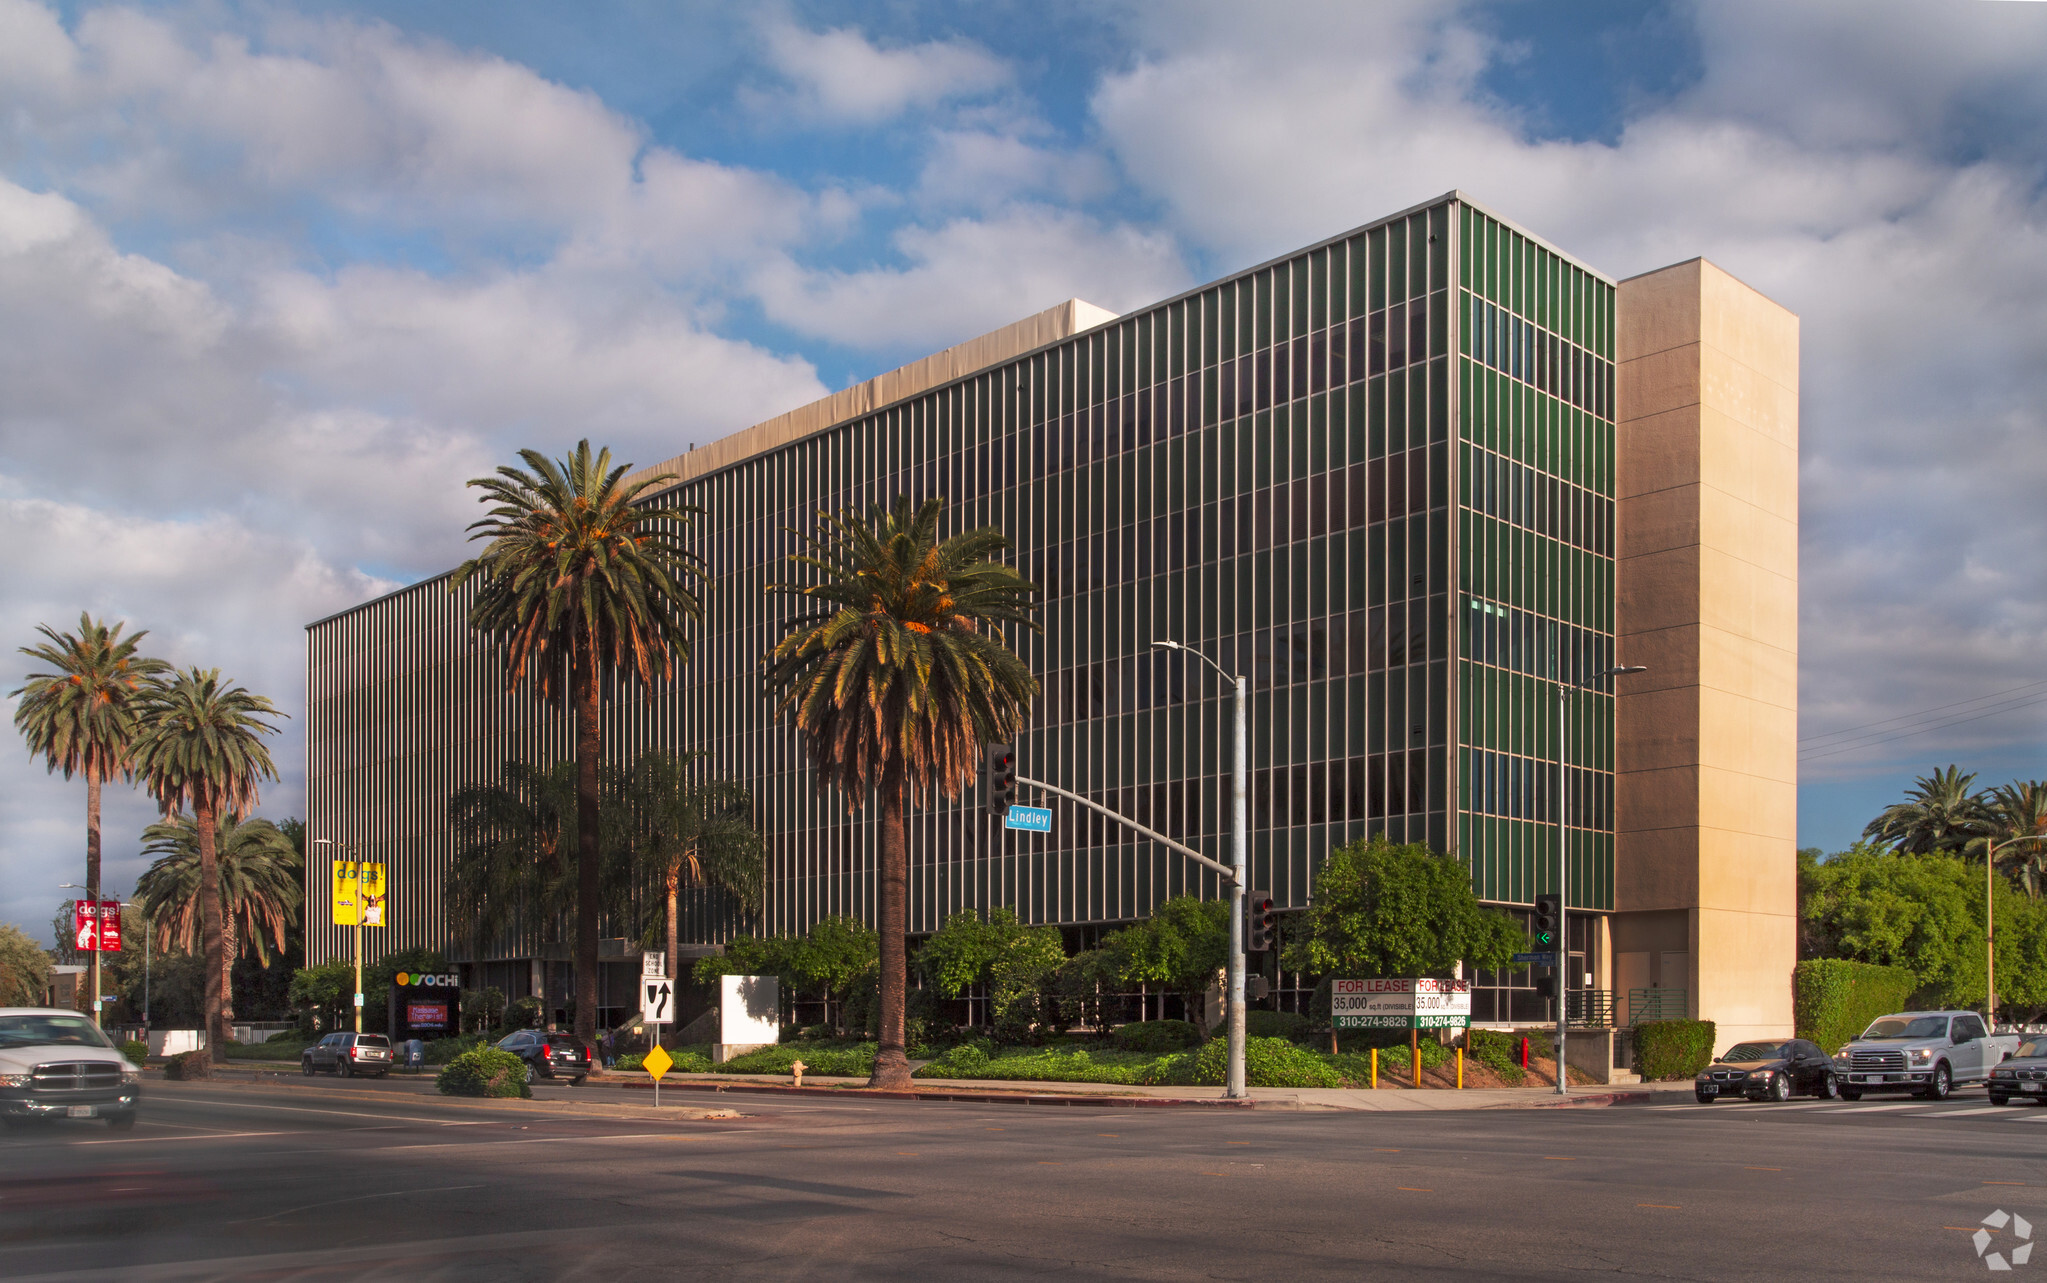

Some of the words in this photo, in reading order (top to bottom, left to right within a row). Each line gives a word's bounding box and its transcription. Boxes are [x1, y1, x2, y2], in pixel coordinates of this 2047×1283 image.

[1009, 809, 1048, 827] Lindley
[1338, 980, 1363, 992] FOR
[1367, 980, 1409, 992] LEASE
[1419, 980, 1438, 991] FOR
[1440, 980, 1468, 992] LEASE
[1334, 997, 1367, 1012] 35,000
[1382, 1003, 1414, 1011] (DIVISIBLE)
[1339, 1016, 1408, 1027] 310-274-9826
[1420, 1016, 1466, 1027] 310-274-9826
